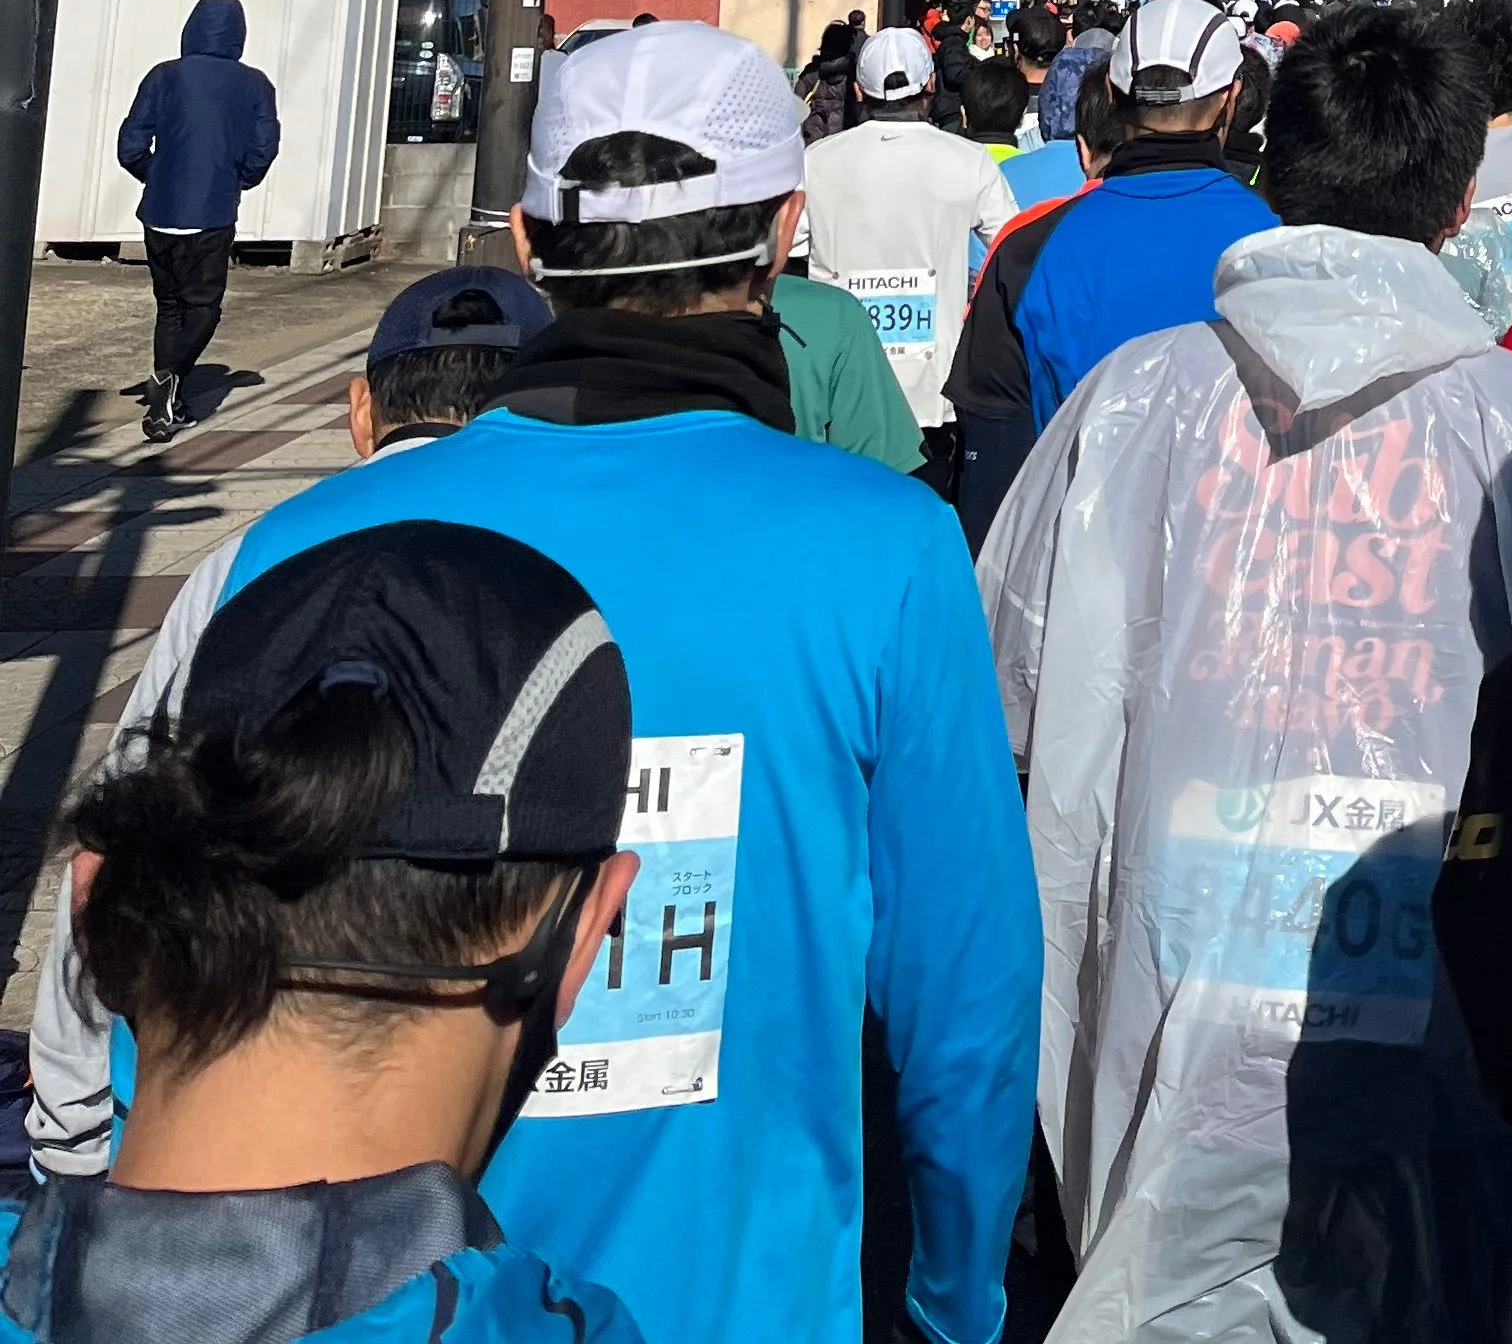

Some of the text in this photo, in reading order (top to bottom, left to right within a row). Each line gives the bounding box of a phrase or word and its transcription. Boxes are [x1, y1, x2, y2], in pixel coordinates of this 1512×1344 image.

[848, 276, 918, 290] HITACHI
[1290, 793, 1406, 832] JX金属
[672, 869, 712, 883] スタート
[672, 882, 713, 896] ブロック
[637, 1012, 662, 1024] Start
